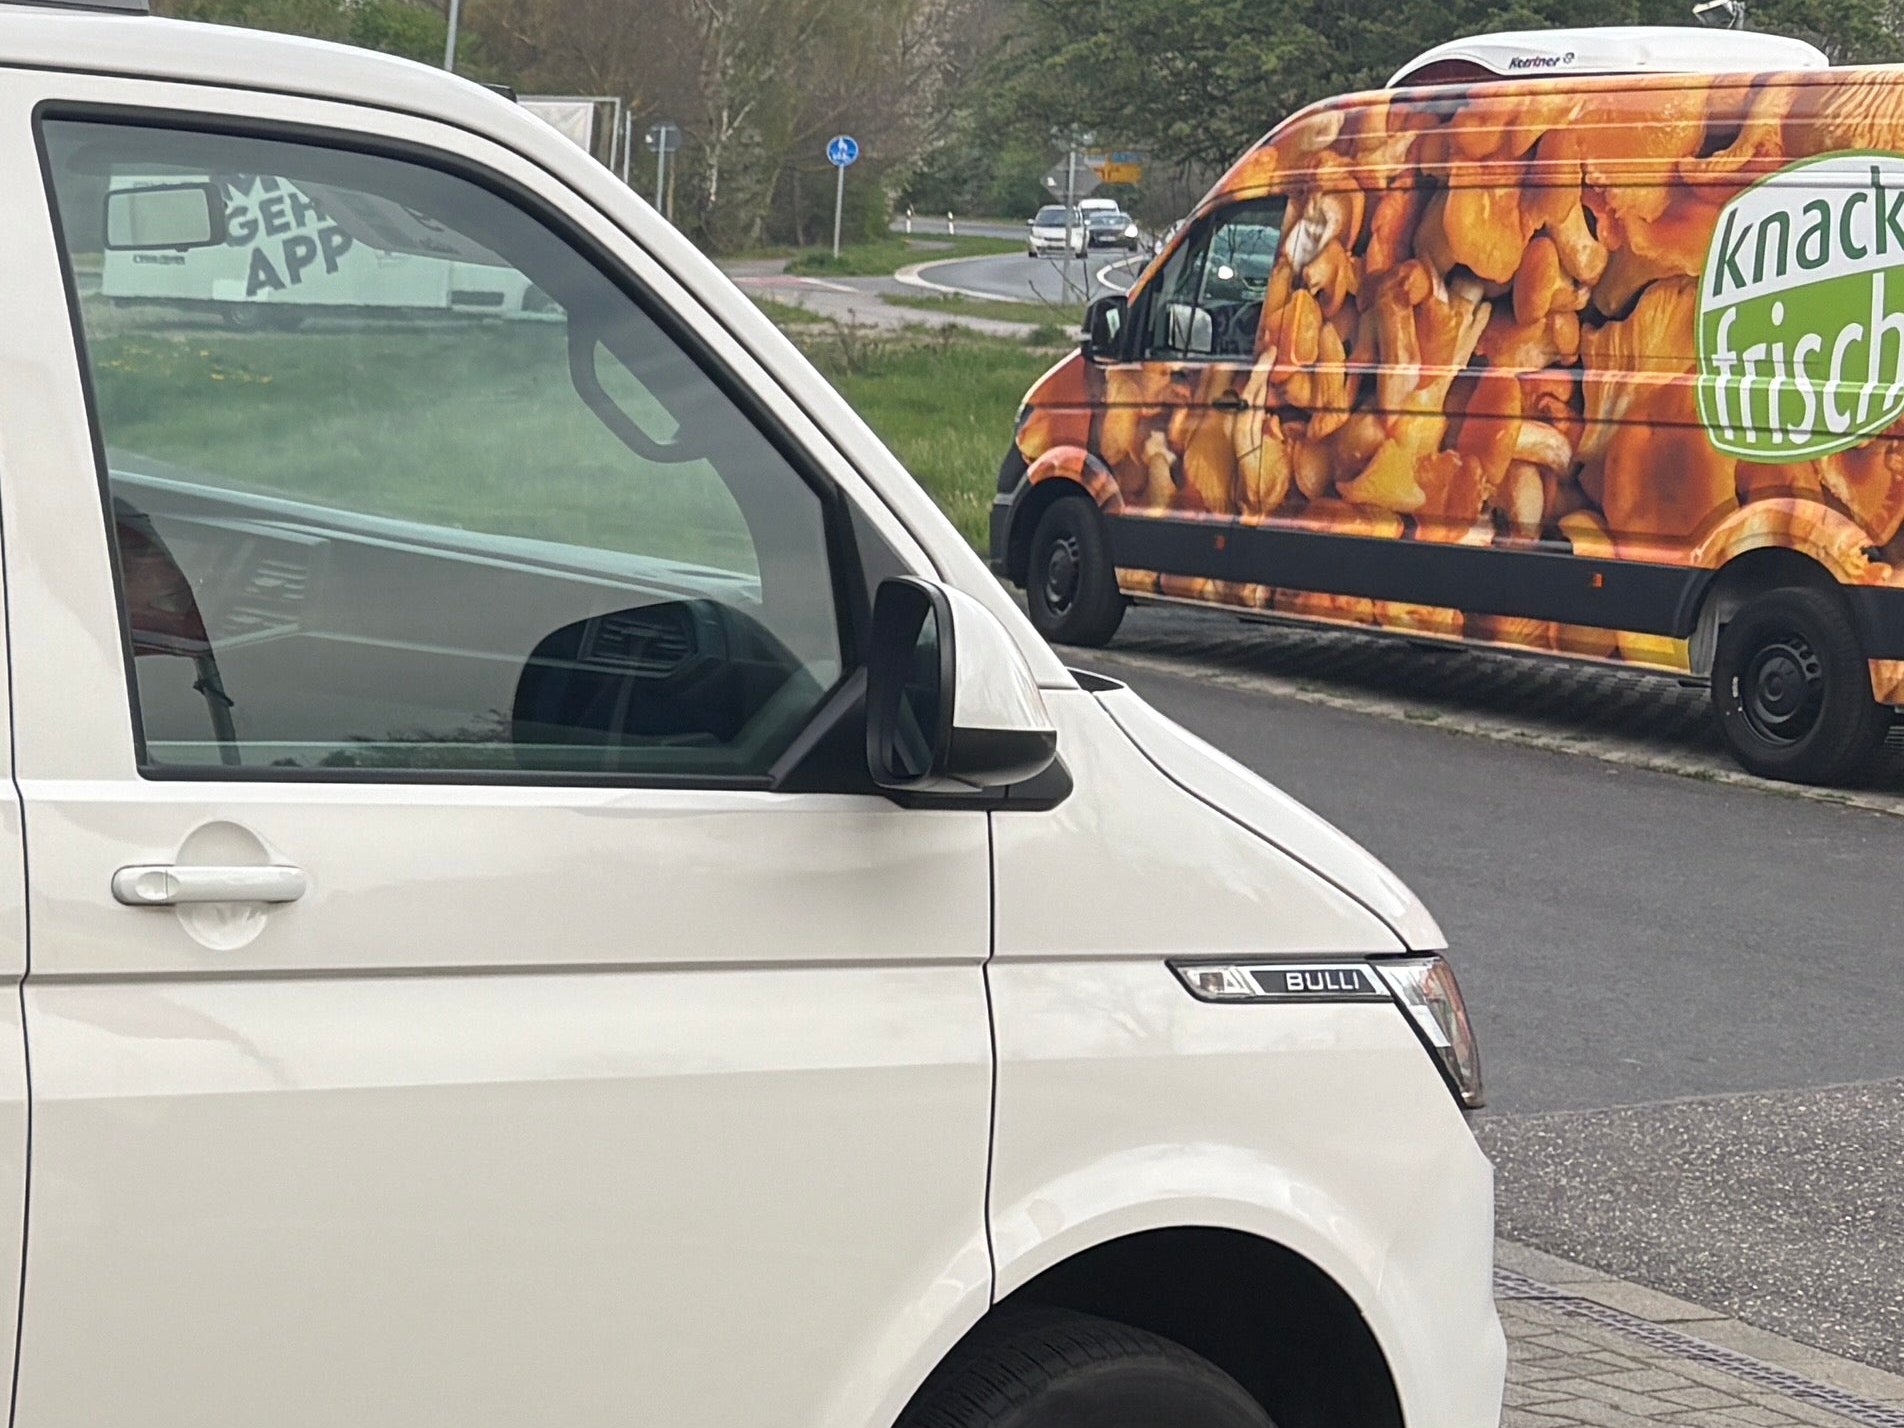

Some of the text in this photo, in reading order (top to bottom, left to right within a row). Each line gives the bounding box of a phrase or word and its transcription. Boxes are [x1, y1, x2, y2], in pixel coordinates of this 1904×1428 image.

[246, 225, 354, 297] APP
[1712, 165, 1904, 297] knack
[1712, 271, 1904, 445] frisch
[1286, 971, 1360, 991] BULLI
